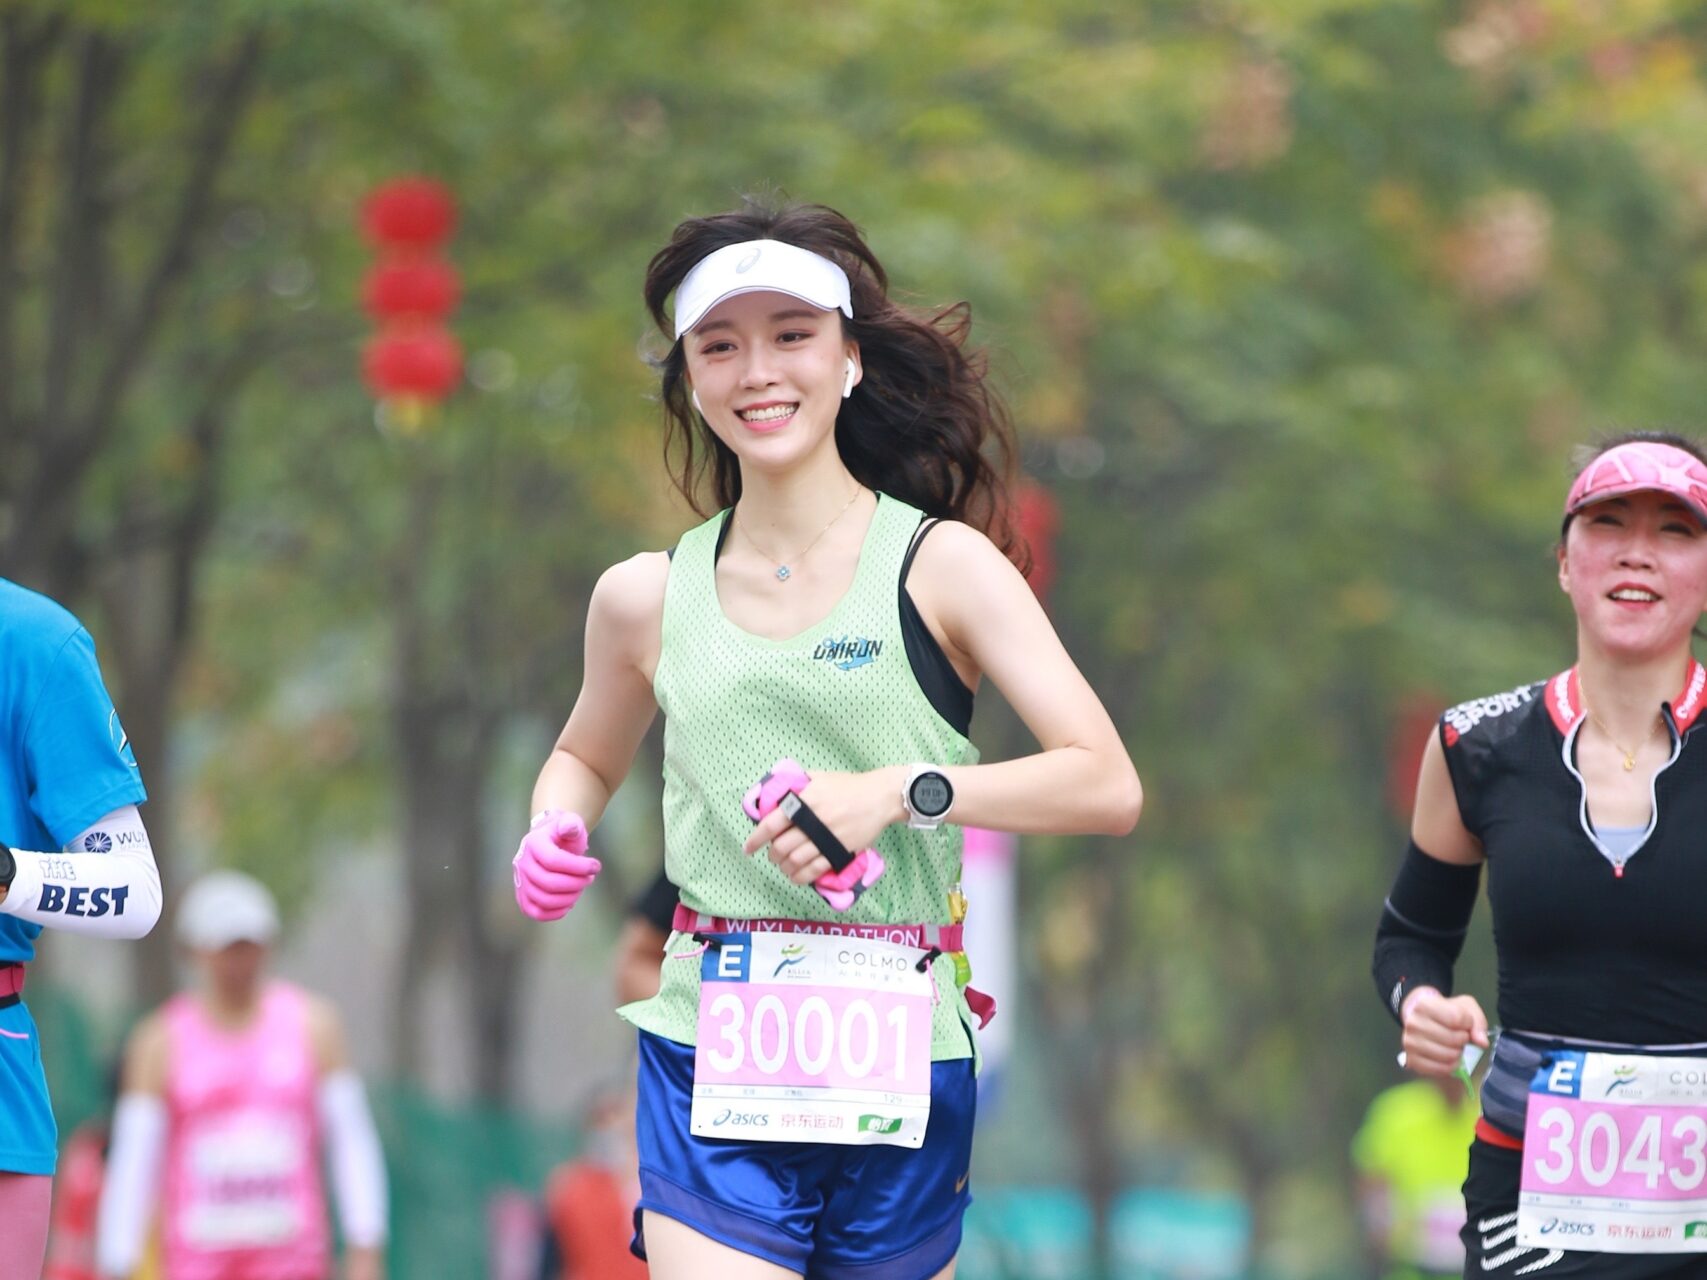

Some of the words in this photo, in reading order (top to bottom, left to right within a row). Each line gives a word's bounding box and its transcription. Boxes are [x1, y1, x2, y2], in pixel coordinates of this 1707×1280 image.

[1452, 685, 1532, 735] SPORT
[39, 857, 76, 880] THE
[36, 882, 129, 917] BEST
[718, 944, 744, 977] E
[838, 950, 908, 971] COLMO
[706, 993, 909, 1081] 30001
[1547, 1060, 1577, 1094] E
[731, 1113, 769, 1127] asics
[1534, 1106, 1707, 1191] 3043
[1558, 1220, 1595, 1236] asics
